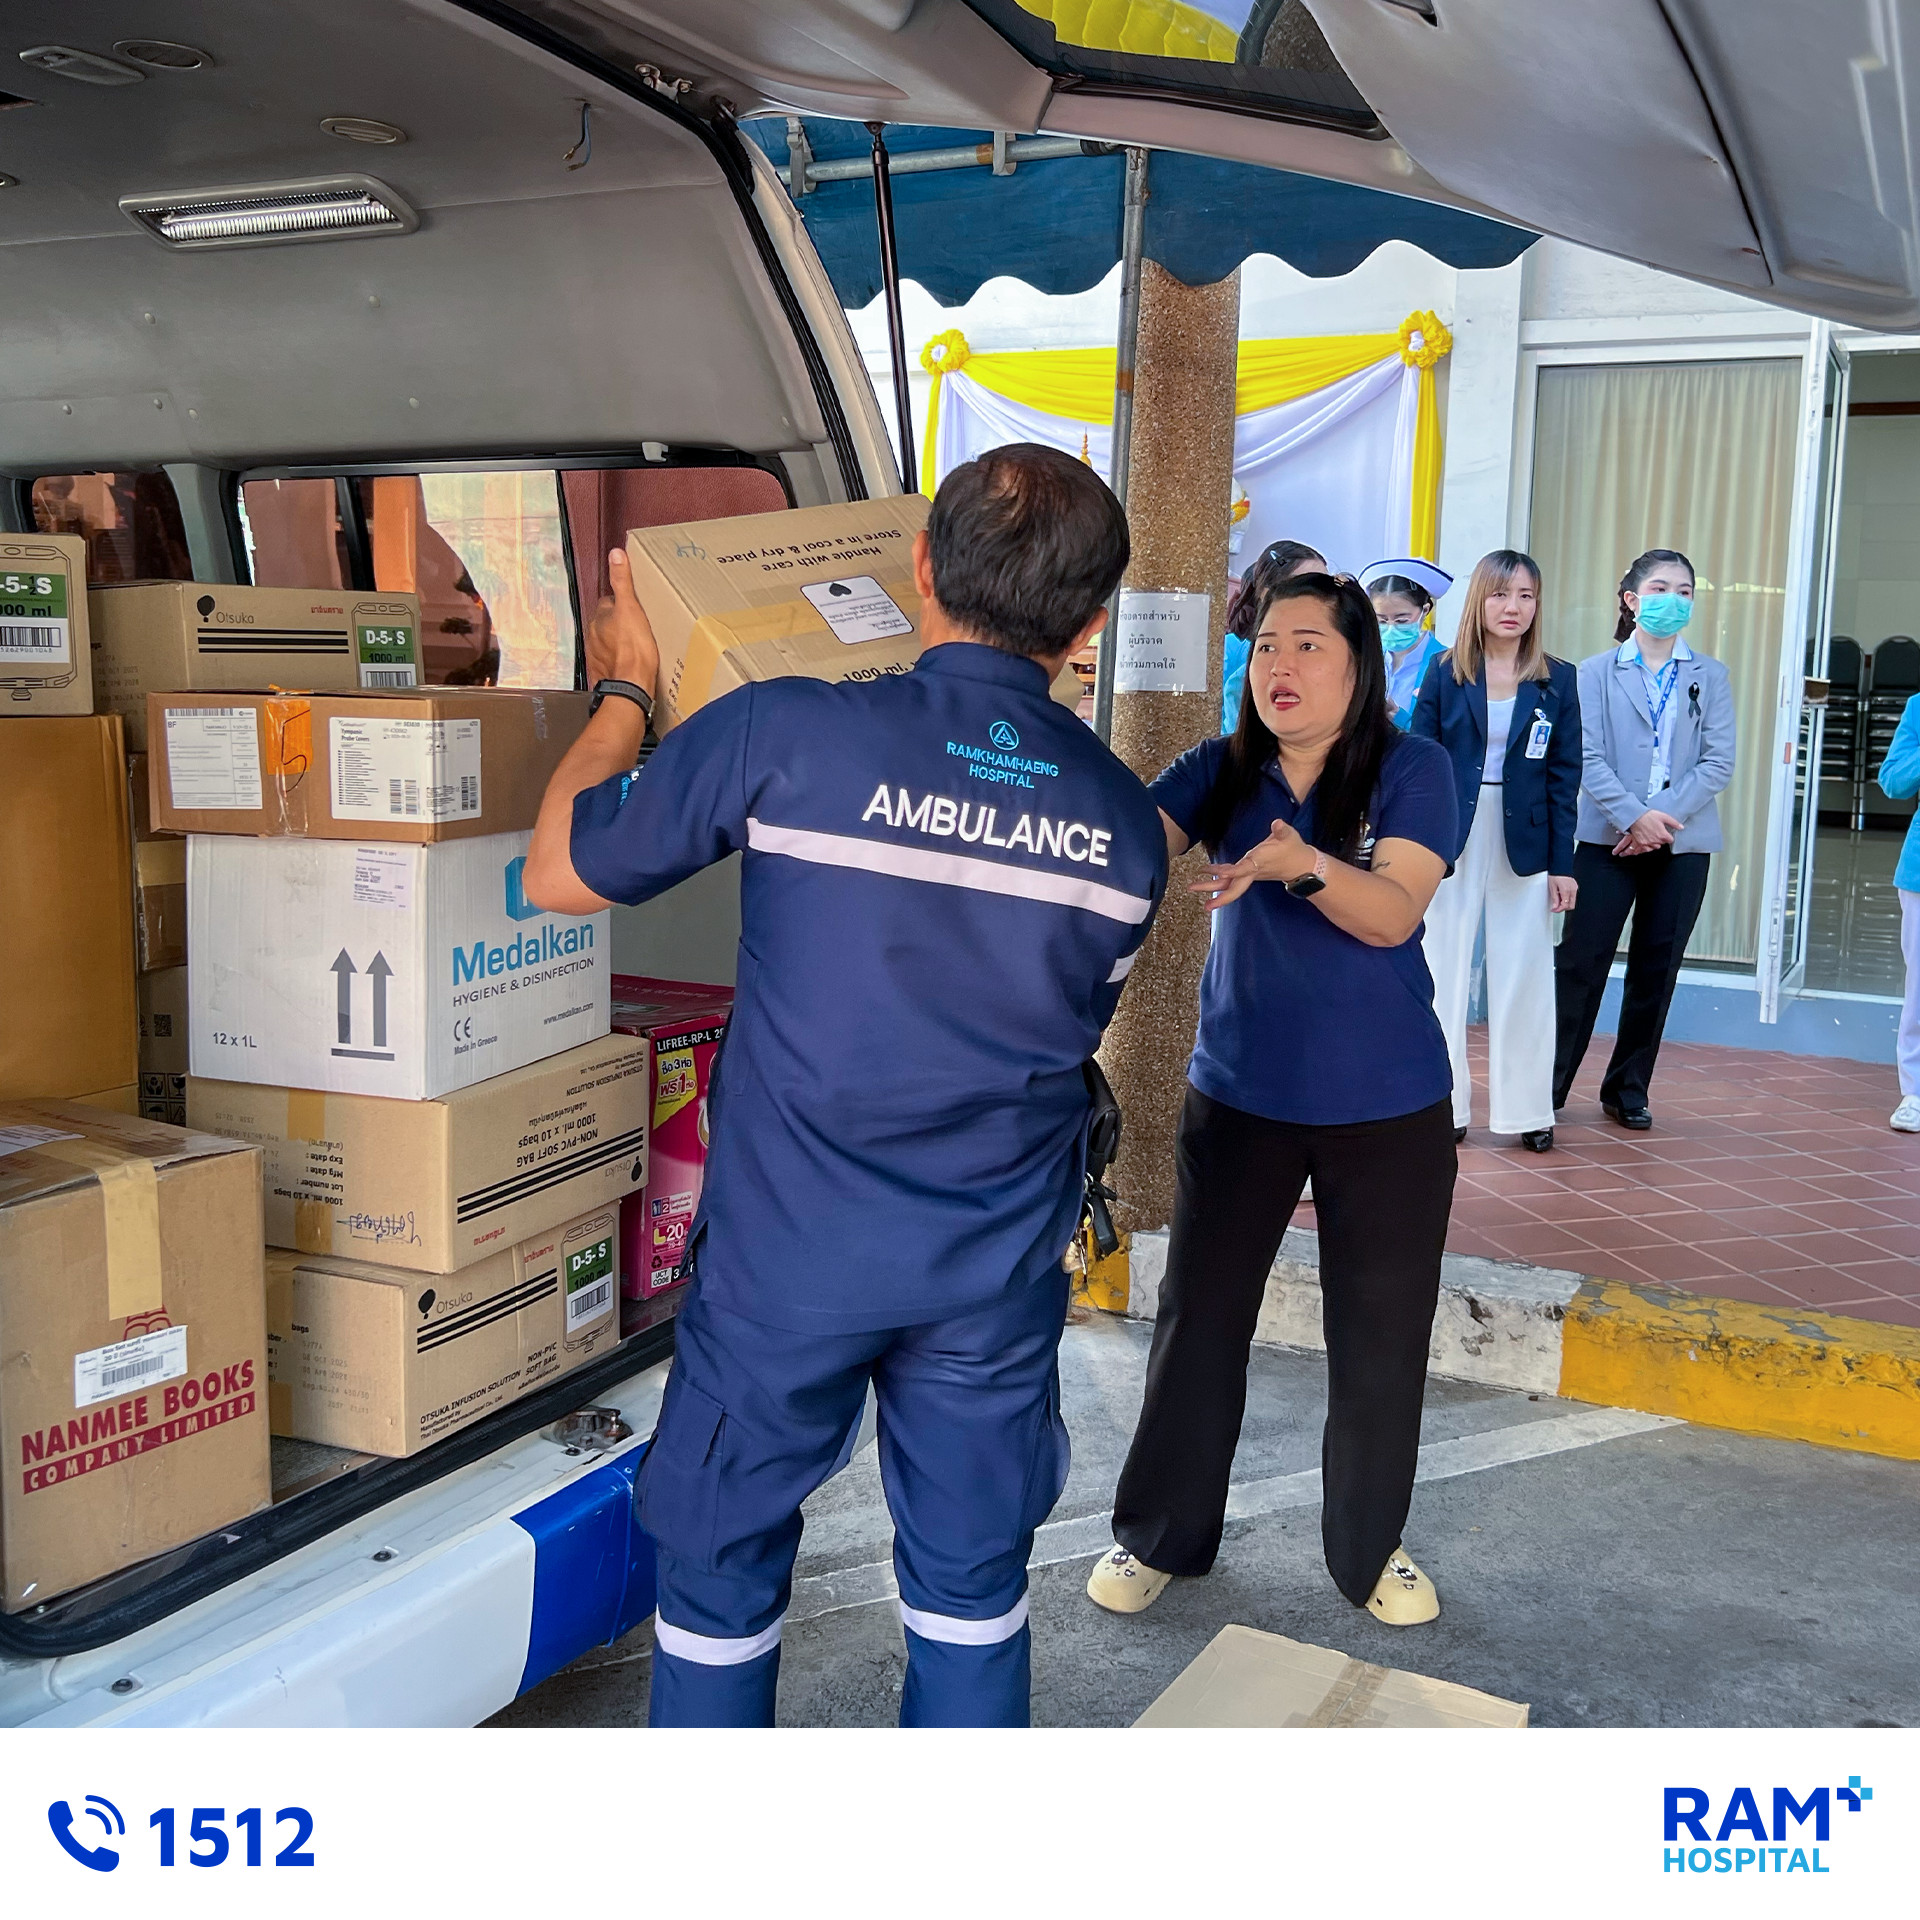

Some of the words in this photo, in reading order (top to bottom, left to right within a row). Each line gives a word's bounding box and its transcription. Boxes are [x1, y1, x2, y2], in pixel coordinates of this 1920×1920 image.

[836, 538, 844, 546] a
[849, 535, 861, 546] in
[864, 529, 902, 544] Store
[760, 545, 785, 560] dry
[786, 545, 800, 555] &
[803, 540, 832, 552] cool
[717, 549, 756, 566] place
[795, 552, 830, 567] with
[832, 546, 882, 562] Handle
[761, 561, 794, 573] care
[31, 605, 52, 617] ml
[216, 612, 255, 624] Otsuka
[1128, 632, 1163, 648] ผู้บริจาค
[368, 653, 393, 663] 1000
[395, 654, 407, 663] ml
[843, 667, 882, 681] 1000
[884, 662, 908, 675] ml.
[946, 741, 1059, 777] RAMKHAMHAENG
[969, 763, 1035, 789] HOSPITAL
[861, 784, 1112, 867] AMBULANCE
[452, 923, 594, 986] Medalkan
[453, 982, 507, 1008] HYGIENE
[510, 979, 520, 991] &
[523, 957, 594, 988] DISINFECTION
[543, 1002, 594, 1026] www.medalkan.com
[212, 1031, 227, 1045] 12
[230, 1037, 239, 1047] x
[242, 1034, 257, 1048] 1L
[454, 1043, 470, 1056] Made
[477, 1035, 498, 1049] Greece
[656, 1030, 712, 1052] LIFREE-RP-L
[623, 1064, 644, 1077] OTSUKA
[596, 1072, 623, 1087] INFUSION
[566, 1080, 595, 1097] SOLUTION
[562, 1118, 575, 1132] ml.
[576, 1113, 597, 1127] 1000
[541, 1128, 552, 1140] 10
[554, 1126, 560, 1135] x
[518, 1133, 539, 1149] bags
[560, 1128, 598, 1150] NON-PVC
[310, 1153, 328, 1163] date
[537, 1143, 559, 1160] SOFT
[329, 1155, 344, 1165] Exp
[516, 1152, 535, 1168] BAG
[309, 1166, 328, 1176] date
[328, 1168, 344, 1179] Mfg
[604, 1159, 632, 1178] Otsuka
[300, 1179, 330, 1189] number
[330, 1183, 344, 1193] Lot
[273, 1188, 293, 1198] bags
[293, 1191, 303, 1200] 10
[324, 1196, 344, 1206] 1000
[653, 1228, 666, 1244] L
[666, 1222, 684, 1242] 20
[574, 1270, 595, 1290] 1000
[596, 1266, 607, 1280] ml
[652, 1276, 670, 1286] CODE
[655, 1270, 668, 1279] UCT
[436, 1291, 473, 1314] Otsuka
[291, 1323, 310, 1334] bags
[527, 1341, 558, 1364] NON-PVC
[525, 1360, 542, 1376] SOFT
[543, 1353, 557, 1369] BAG
[420, 1404, 450, 1424] OTSUKA
[450, 1388, 487, 1412] INFUSION
[487, 1369, 521, 1393] SOLUTION
[21, 1395, 148, 1465] NANMEE
[164, 1360, 255, 1417] BOOKS
[420, 1432, 432, 1441] Thai
[449, 1402, 486, 1427] Pharmaceutical
[420, 1413, 455, 1432] Manufactured
[29, 1434, 145, 1489] COMPANY
[161, 1398, 251, 1443] LIMITED
